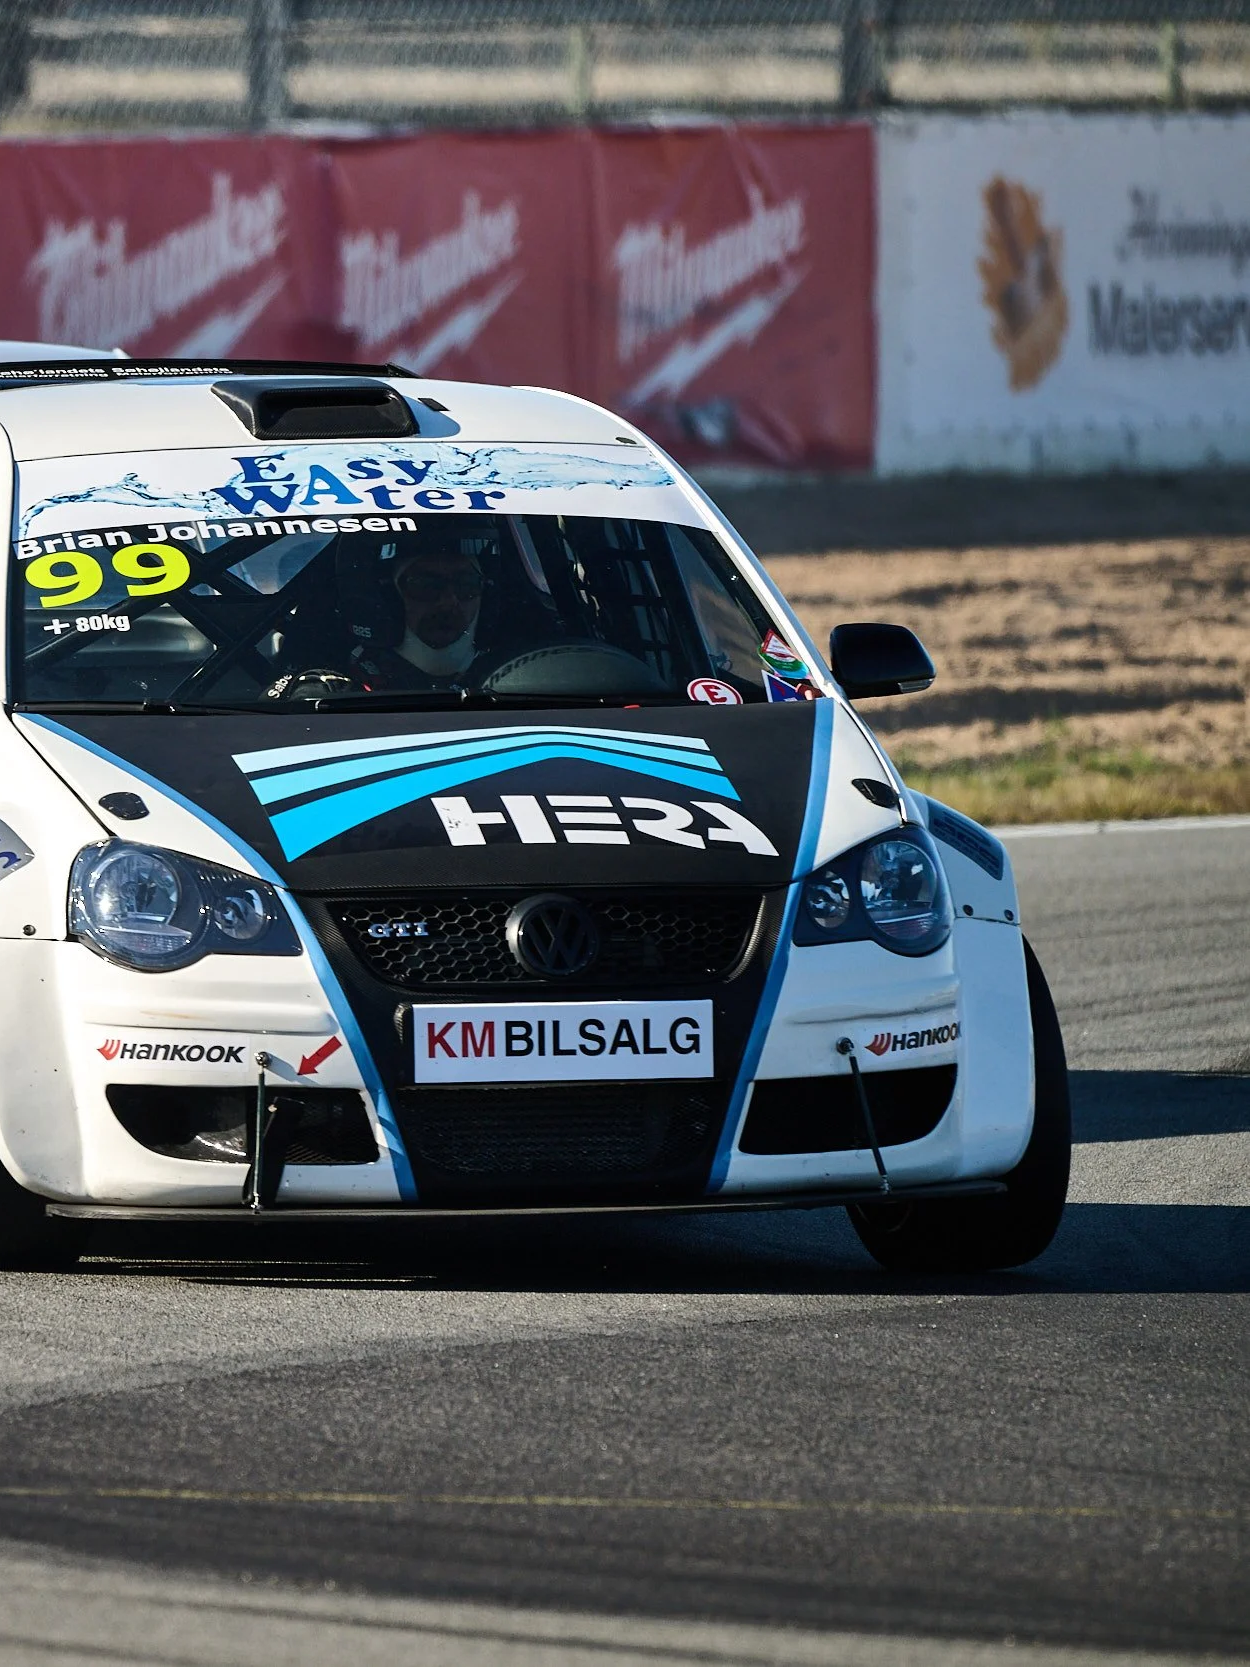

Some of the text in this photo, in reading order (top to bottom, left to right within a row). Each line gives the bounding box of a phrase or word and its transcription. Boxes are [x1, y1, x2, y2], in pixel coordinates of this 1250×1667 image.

[17, 516, 418, 561] Brian Johannesen
[25, 543, 191, 608] 99
[75, 614, 131, 632] 80kg
[431, 794, 780, 857] HERA
[368, 922, 429, 938] GTI
